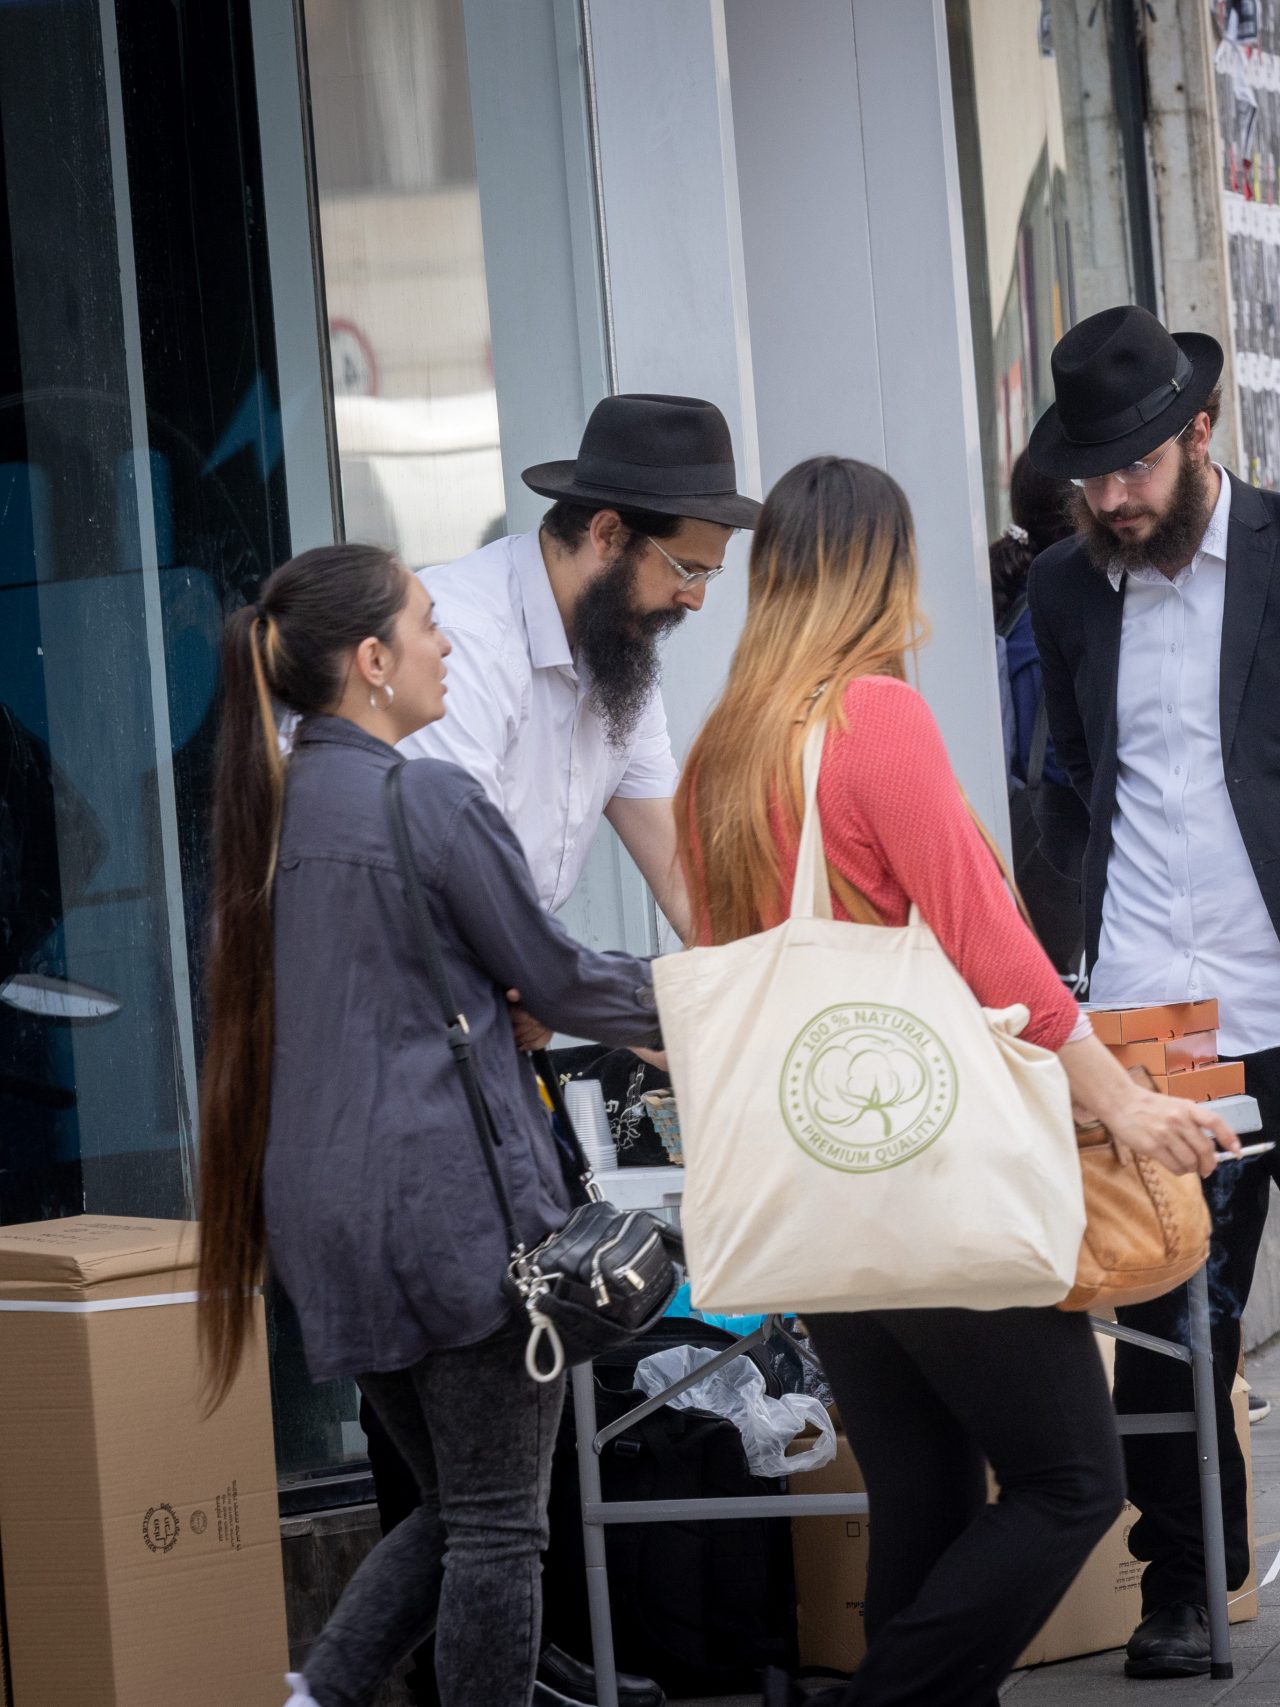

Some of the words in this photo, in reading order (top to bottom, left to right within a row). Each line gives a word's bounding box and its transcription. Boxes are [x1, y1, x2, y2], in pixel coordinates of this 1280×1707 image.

[803, 1022, 830, 1053] 100
[831, 1013, 849, 1027] %
[854, 1011, 931, 1051] NATURAL
[801, 1124, 869, 1164] PREMIUM
[874, 1114, 936, 1164] QUALITY
